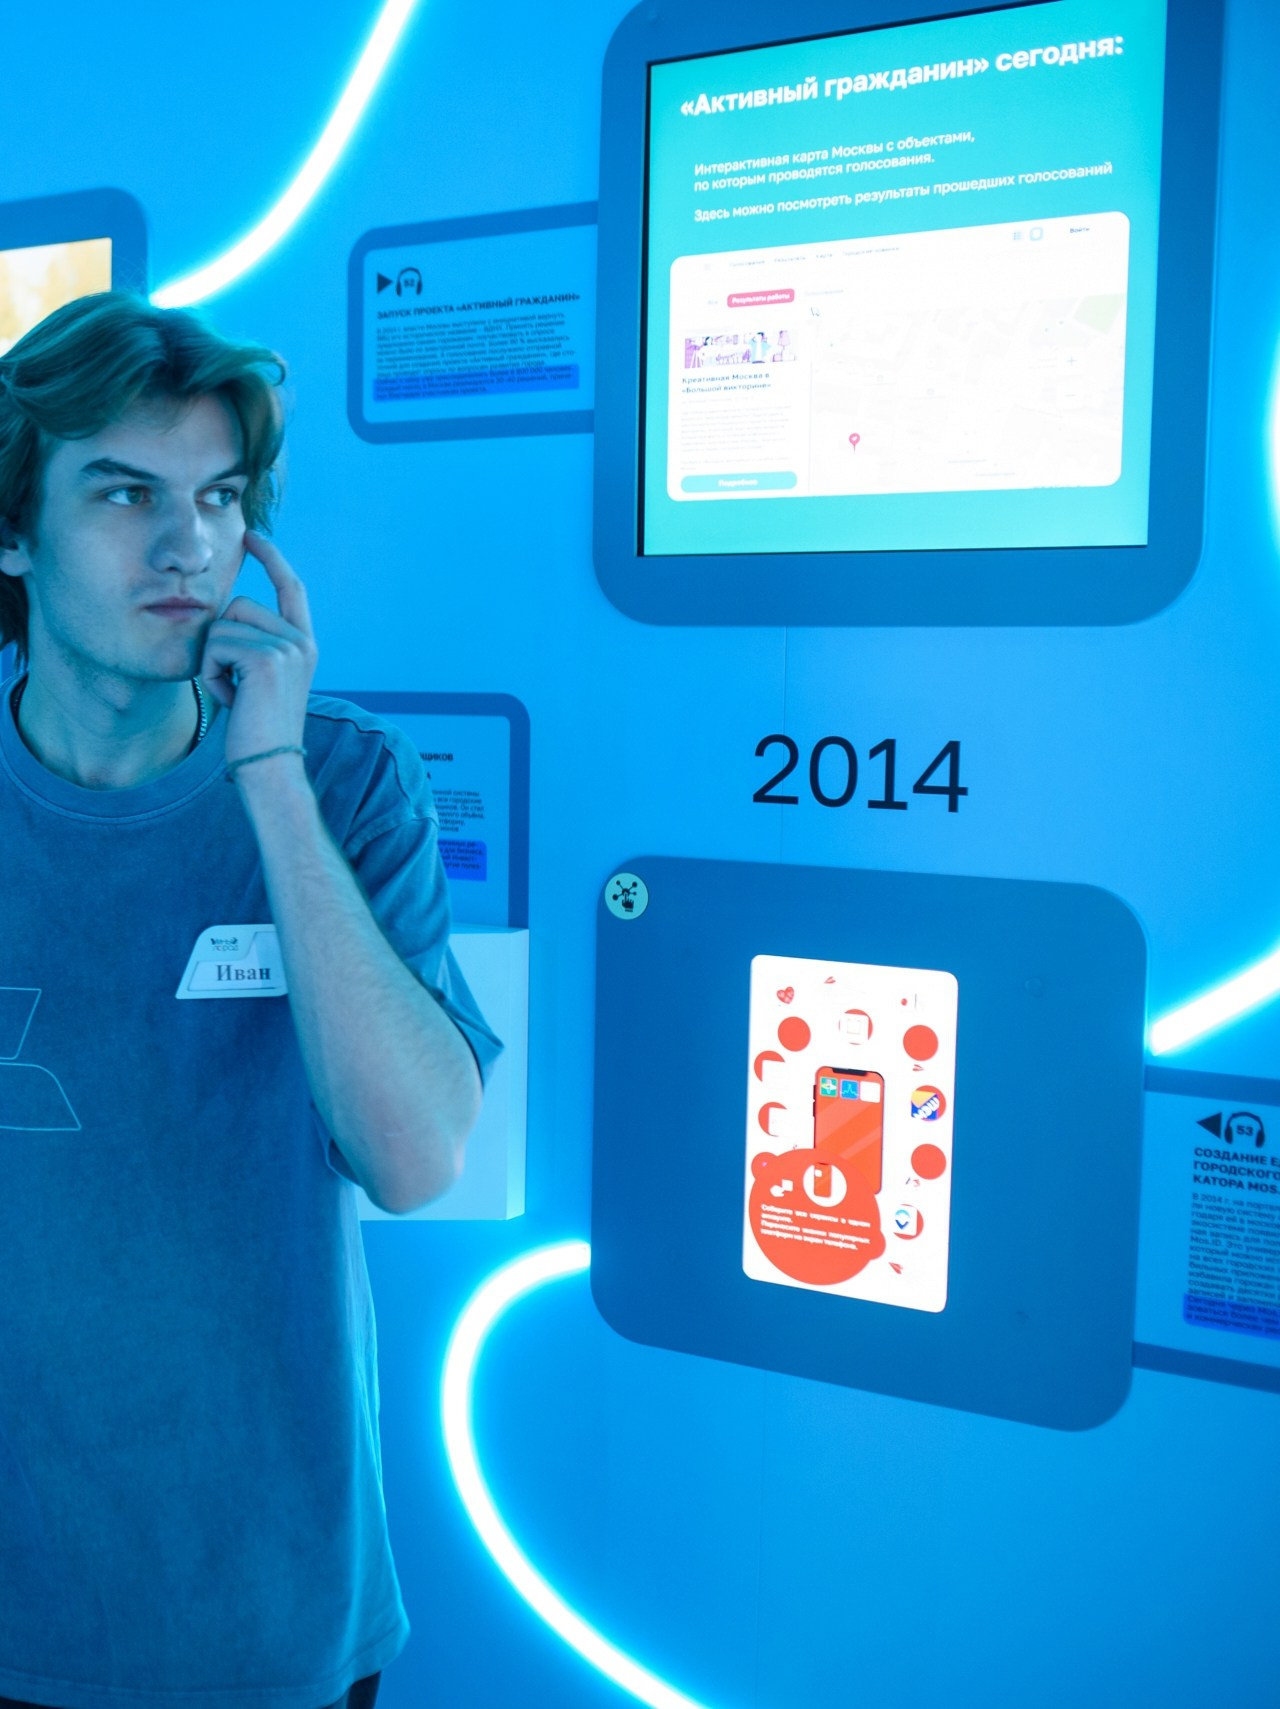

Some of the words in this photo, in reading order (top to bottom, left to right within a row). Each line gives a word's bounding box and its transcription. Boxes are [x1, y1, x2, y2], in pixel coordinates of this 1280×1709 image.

[680, 76, 818, 116] «Активный
[824, 58, 989, 101] гражданин»
[995, 36, 1123, 71] сегодня:
[694, 154, 790, 176] Интерактивная
[791, 149, 828, 165] карта
[831, 143, 884, 159] Москвы
[886, 140, 894, 151] с
[897, 131, 975, 150] объектами,
[694, 181, 709, 192] по
[711, 173, 765, 189] которым
[768, 164, 843, 184] проводятся
[846, 153, 935, 173] голосования.
[694, 208, 730, 222] Здесь
[732, 202, 774, 217] можно
[777, 194, 852, 210] посмотреть
[855, 186, 930, 206] результаты
[933, 175, 1015, 197] прошедших
[1018, 160, 1113, 184] голосований
[753, 735, 969, 814] 2014
[216, 964, 271, 981] Иван
[1236, 1124, 1253, 1137] 53
[1194, 1146, 1268, 1166] СОЗДАНИЕ
[1192, 1173, 1244, 1189] КАТОРА
